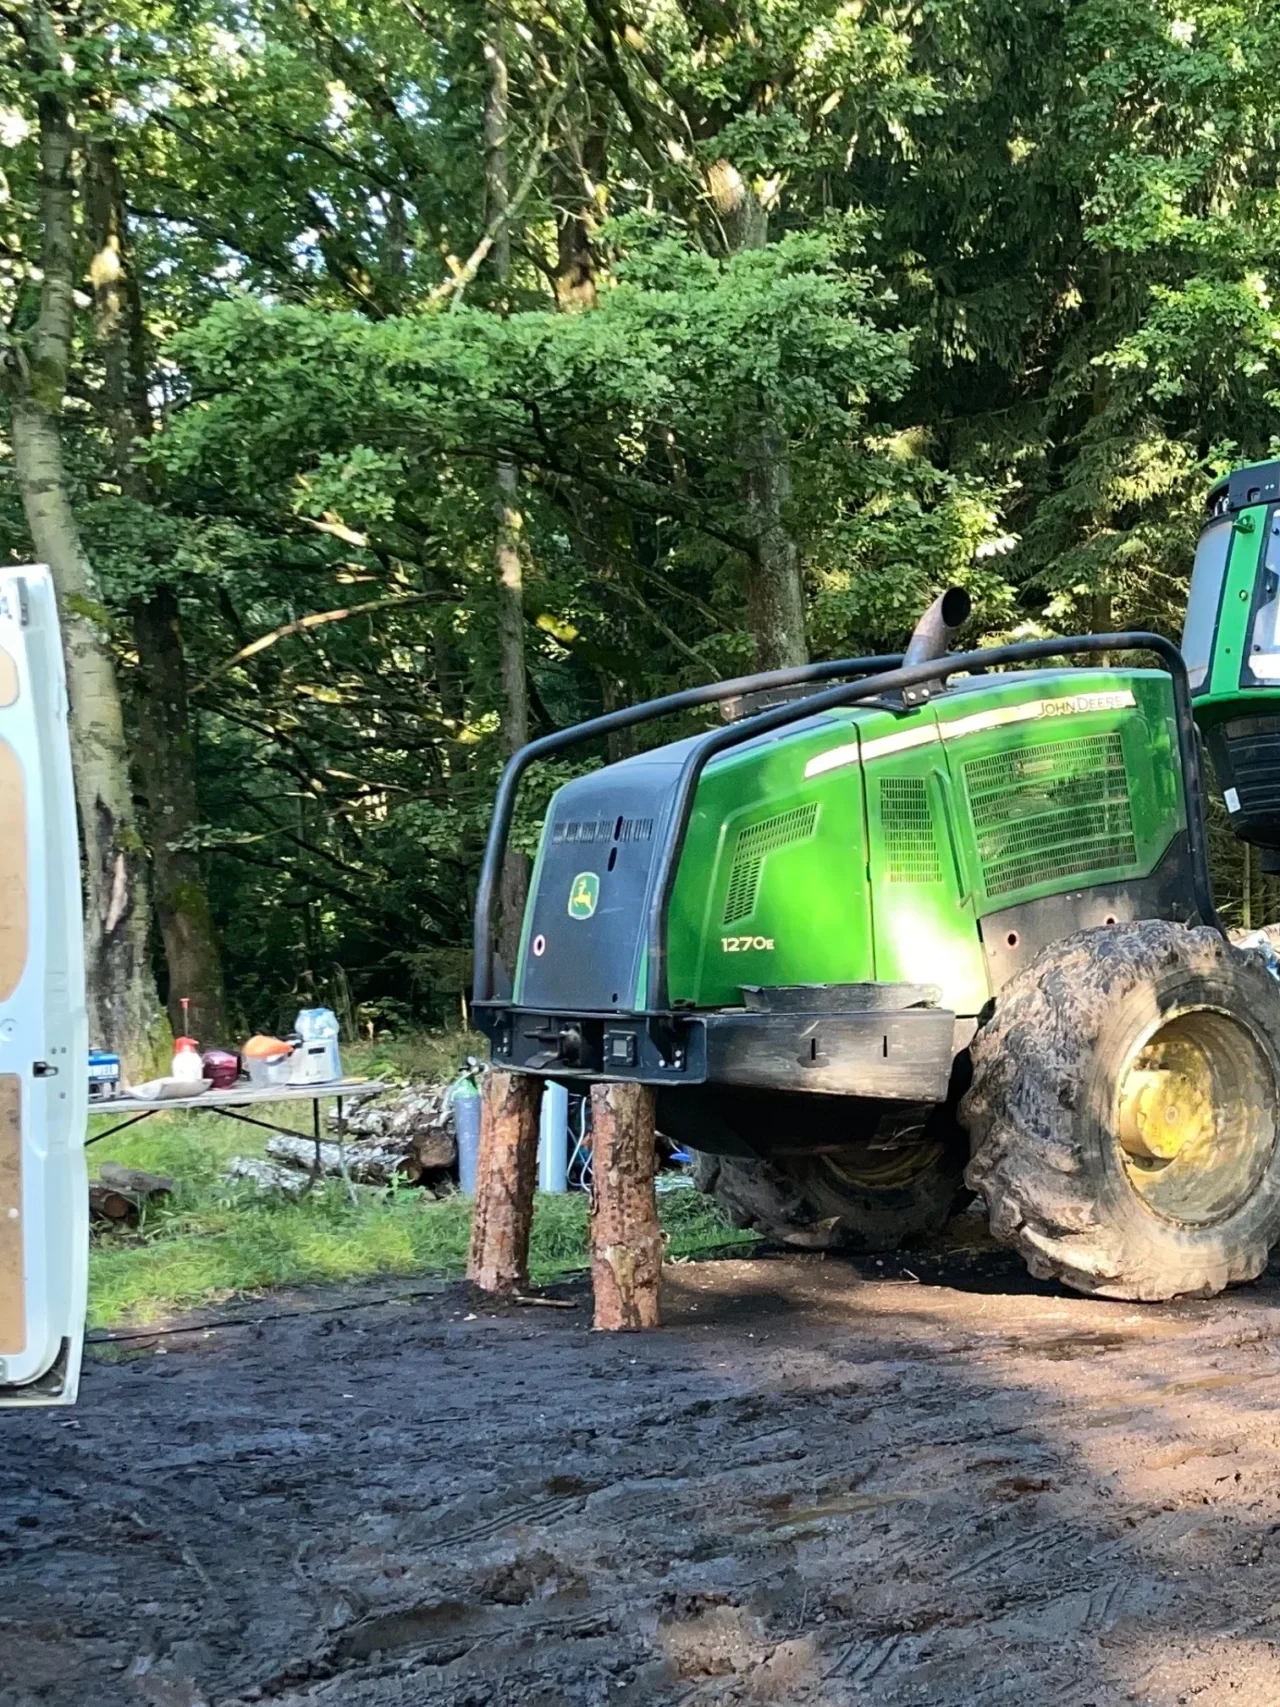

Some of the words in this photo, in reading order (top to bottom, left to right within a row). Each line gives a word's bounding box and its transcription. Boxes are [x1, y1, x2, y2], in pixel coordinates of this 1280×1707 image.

[1039, 702, 1076, 717] JOHN
[1077, 695, 1123, 712] DEERE
[721, 936, 775, 953] 1270E
